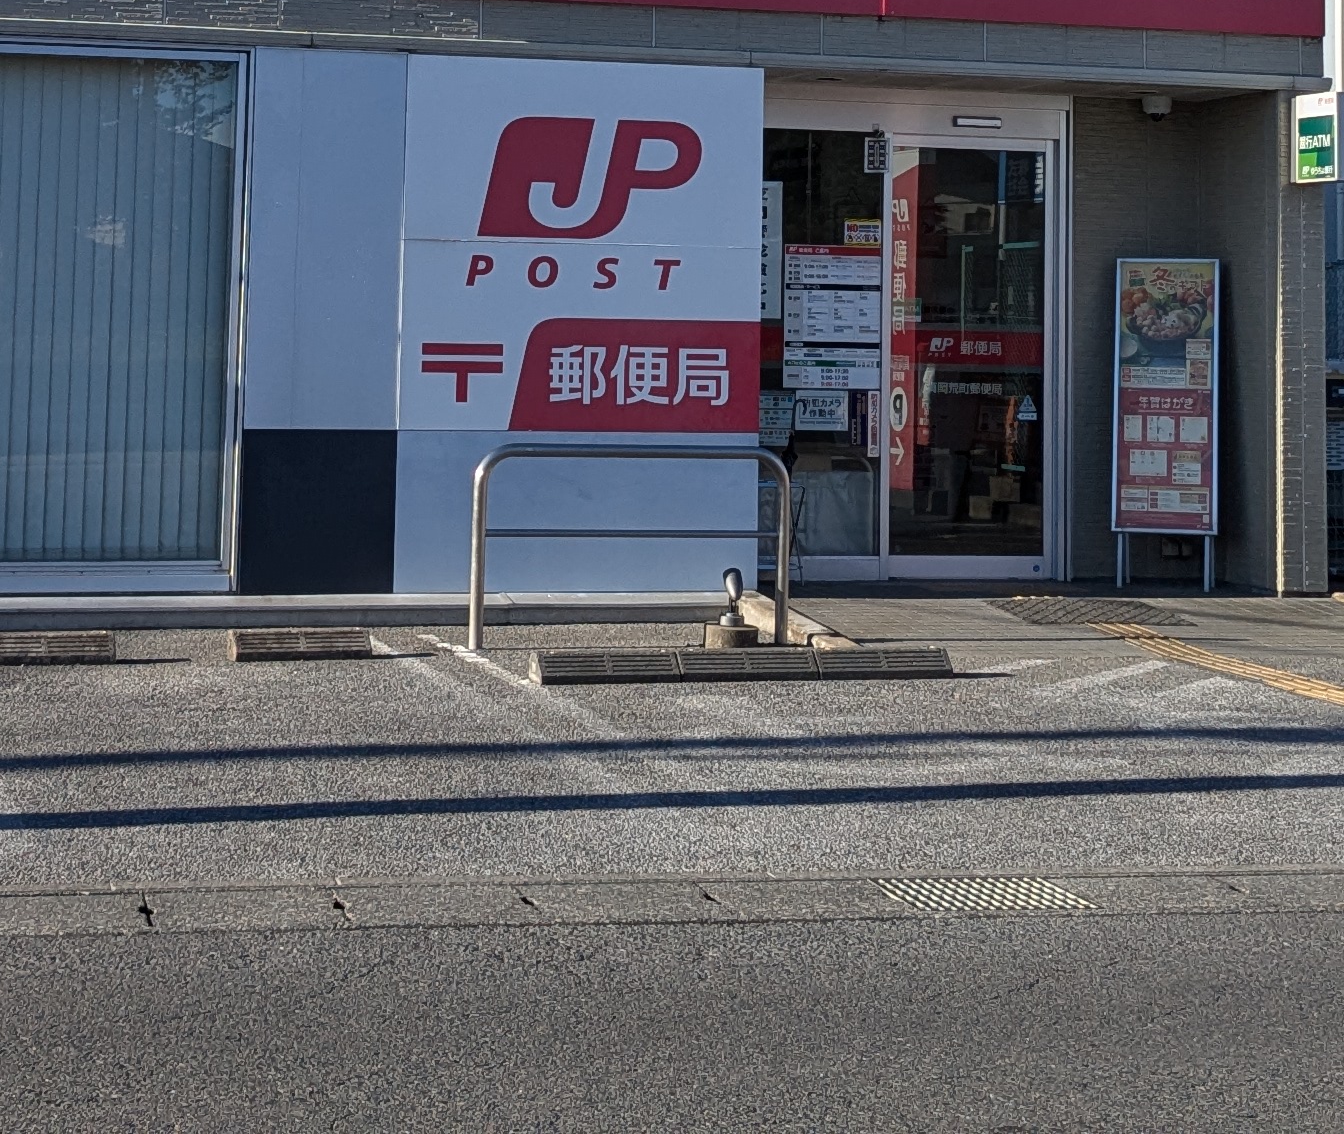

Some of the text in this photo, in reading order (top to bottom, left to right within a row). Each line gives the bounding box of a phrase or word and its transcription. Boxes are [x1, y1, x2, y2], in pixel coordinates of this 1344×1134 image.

[465, 254, 682, 291] POST
[960, 340, 1002, 357] 郵便局
[549, 344, 730, 406] 郵便局
[1138, 396, 1194, 409] 年賀はがき
